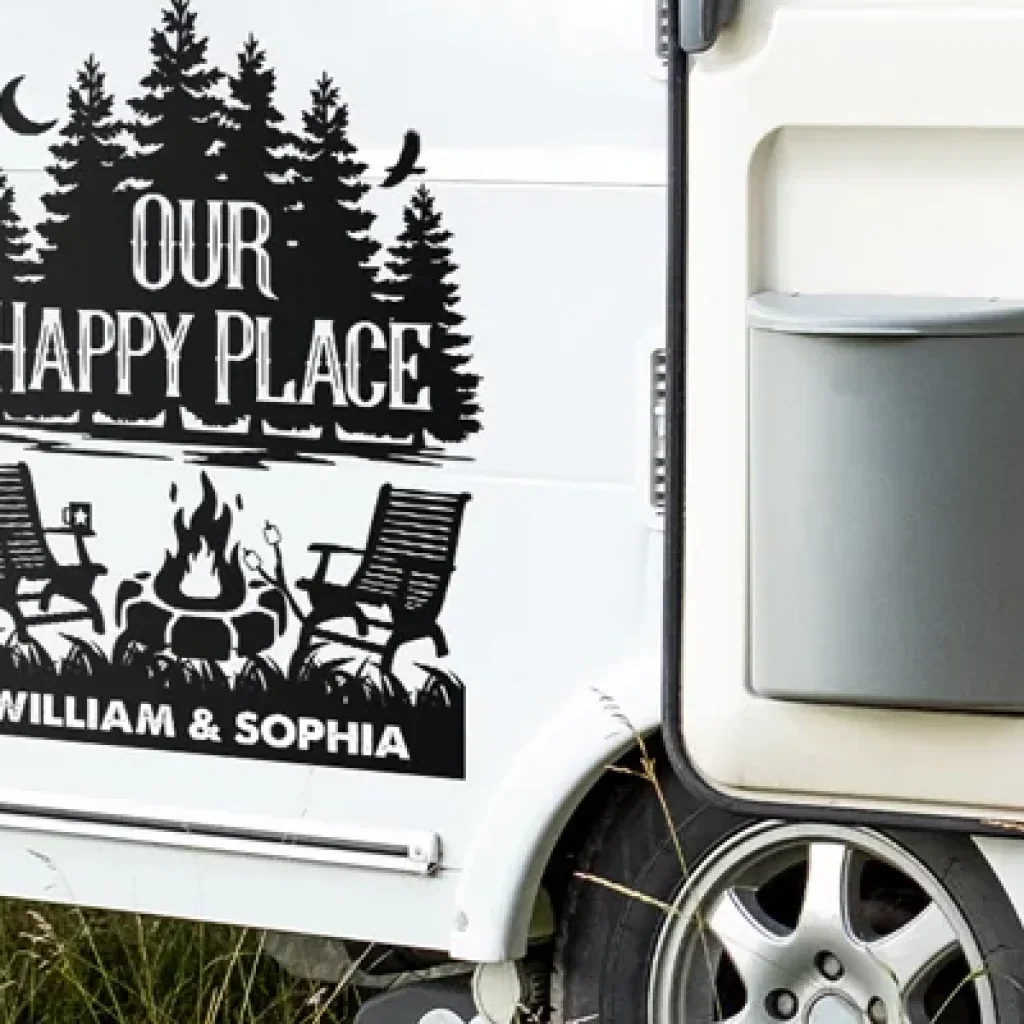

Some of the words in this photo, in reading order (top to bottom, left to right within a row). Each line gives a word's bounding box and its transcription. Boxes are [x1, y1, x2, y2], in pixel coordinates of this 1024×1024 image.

[131, 194, 280, 300] OUR
[215, 310, 432, 410] PLACE
[188, 708, 221, 743] &
[234, 710, 411, 761] SOPHIA
